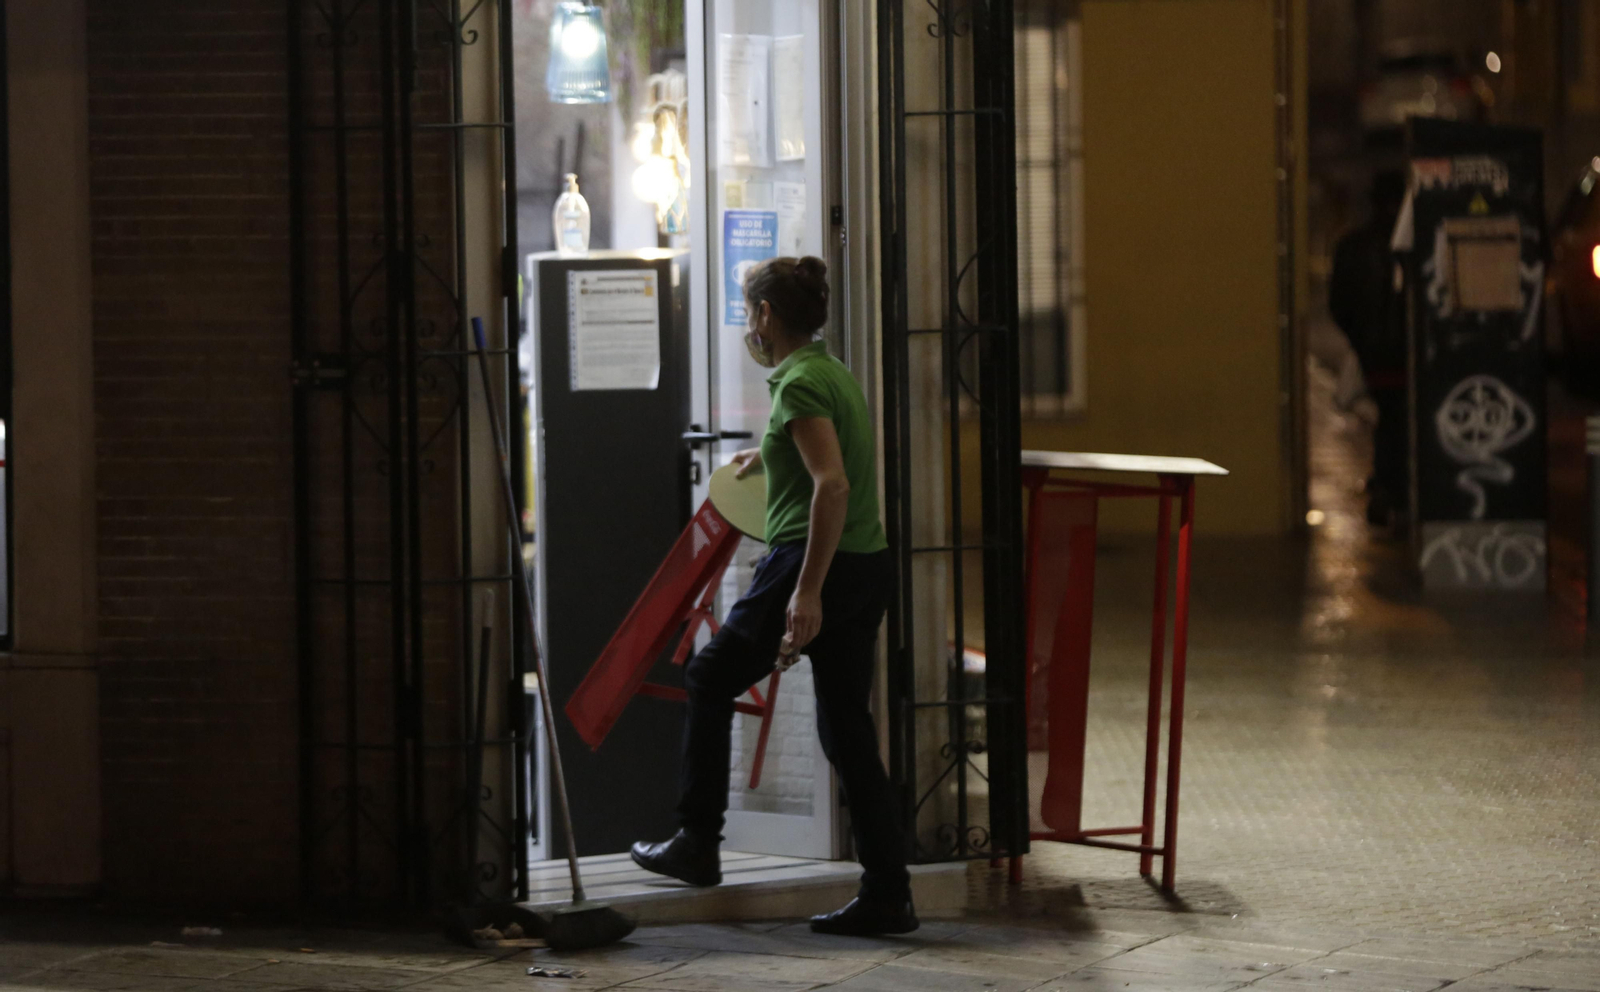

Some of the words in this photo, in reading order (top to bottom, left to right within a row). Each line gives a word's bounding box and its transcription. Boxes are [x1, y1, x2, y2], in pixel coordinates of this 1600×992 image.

[739, 220, 752, 228] USO
[754, 220, 763, 228] DE
[732, 229, 772, 237] MASCARILLA
[730, 238, 773, 247] OBLIGATORIO
